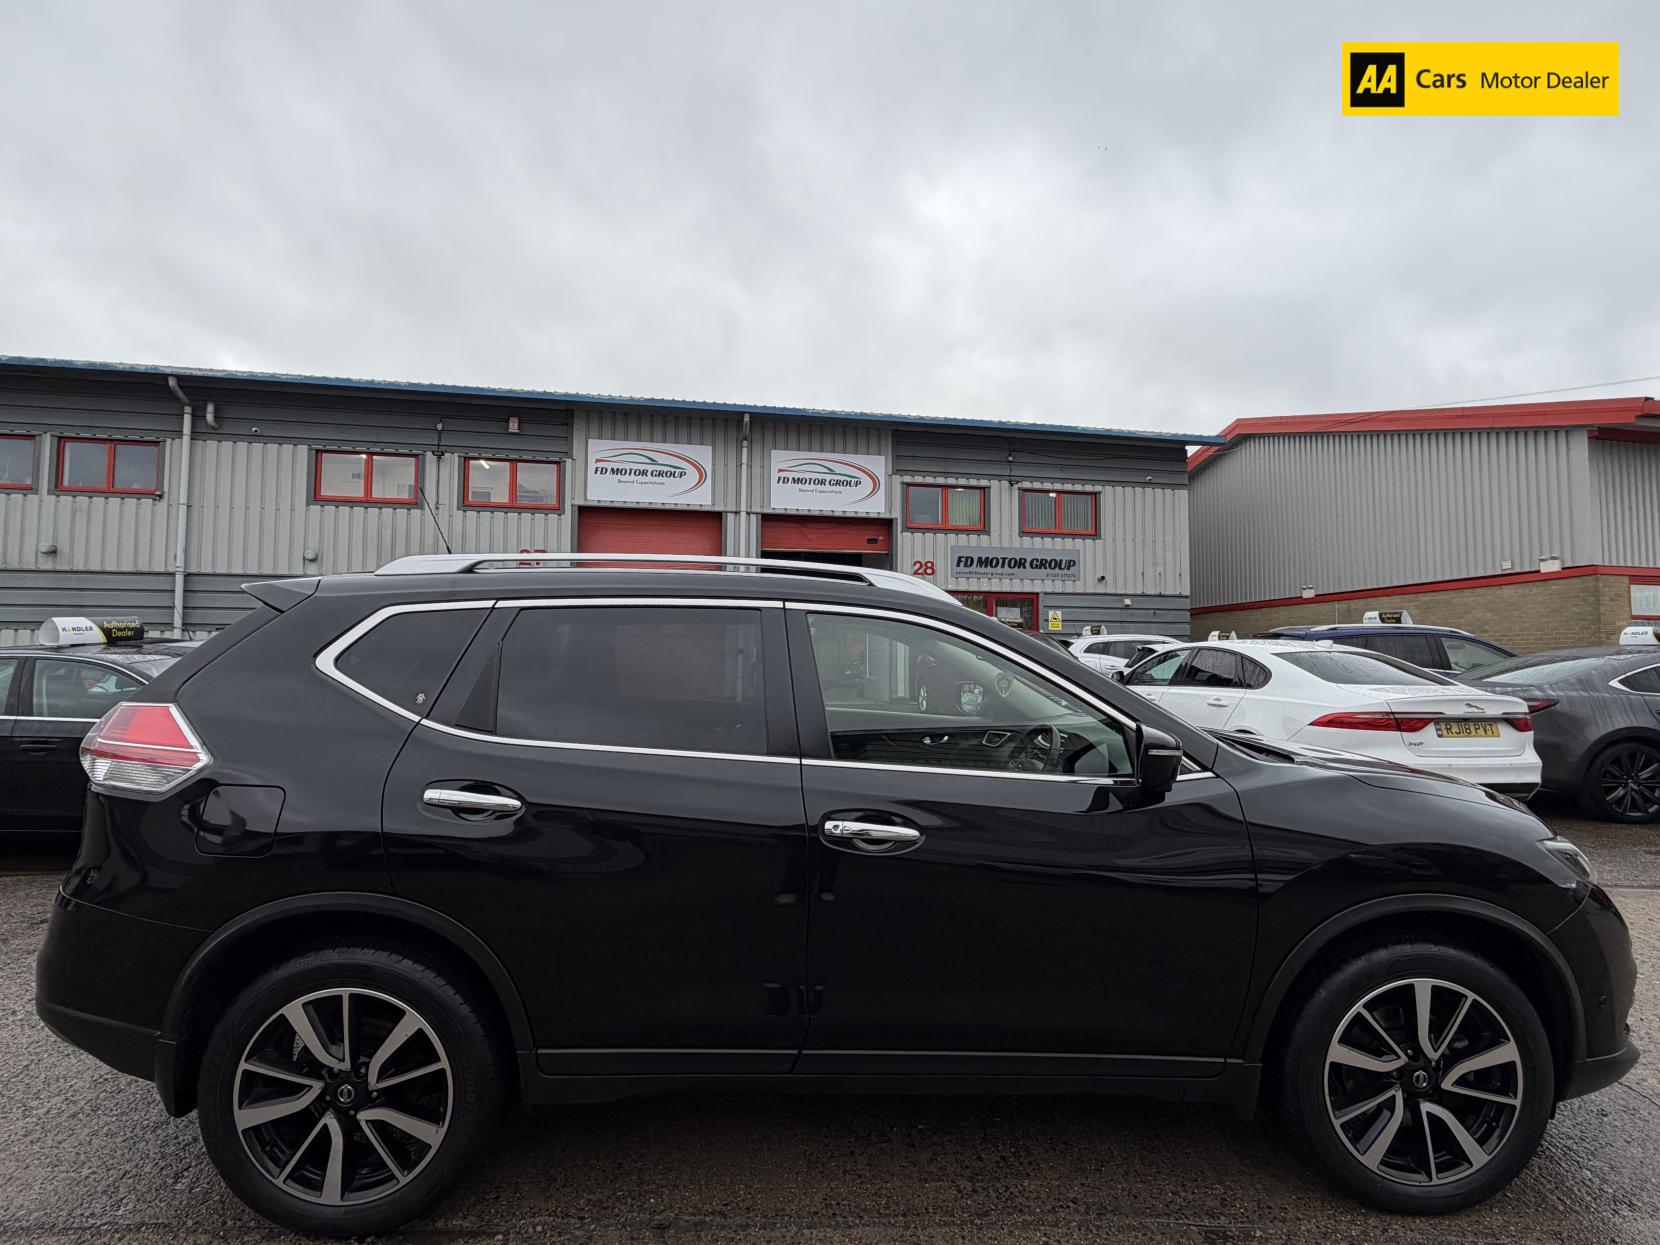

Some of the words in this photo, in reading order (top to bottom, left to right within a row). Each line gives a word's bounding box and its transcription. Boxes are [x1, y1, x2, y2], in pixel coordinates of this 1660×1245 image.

[594, 467, 608, 475] FD
[609, 467, 649, 477] MOTOR
[650, 469, 687, 479] GROUP
[777, 476, 790, 484] FD
[790, 477, 827, 486] MOTOR
[828, 479, 862, 488] GROUP
[912, 560, 935, 576] 28
[956, 556, 975, 568] FD
[976, 556, 1028, 569] MOTOR
[1029, 558, 1077, 571] GROUP
[111, 629, 135, 637] Dealer
[1444, 723, 1473, 735] RJ18
[1473, 723, 1496, 736] PVT
